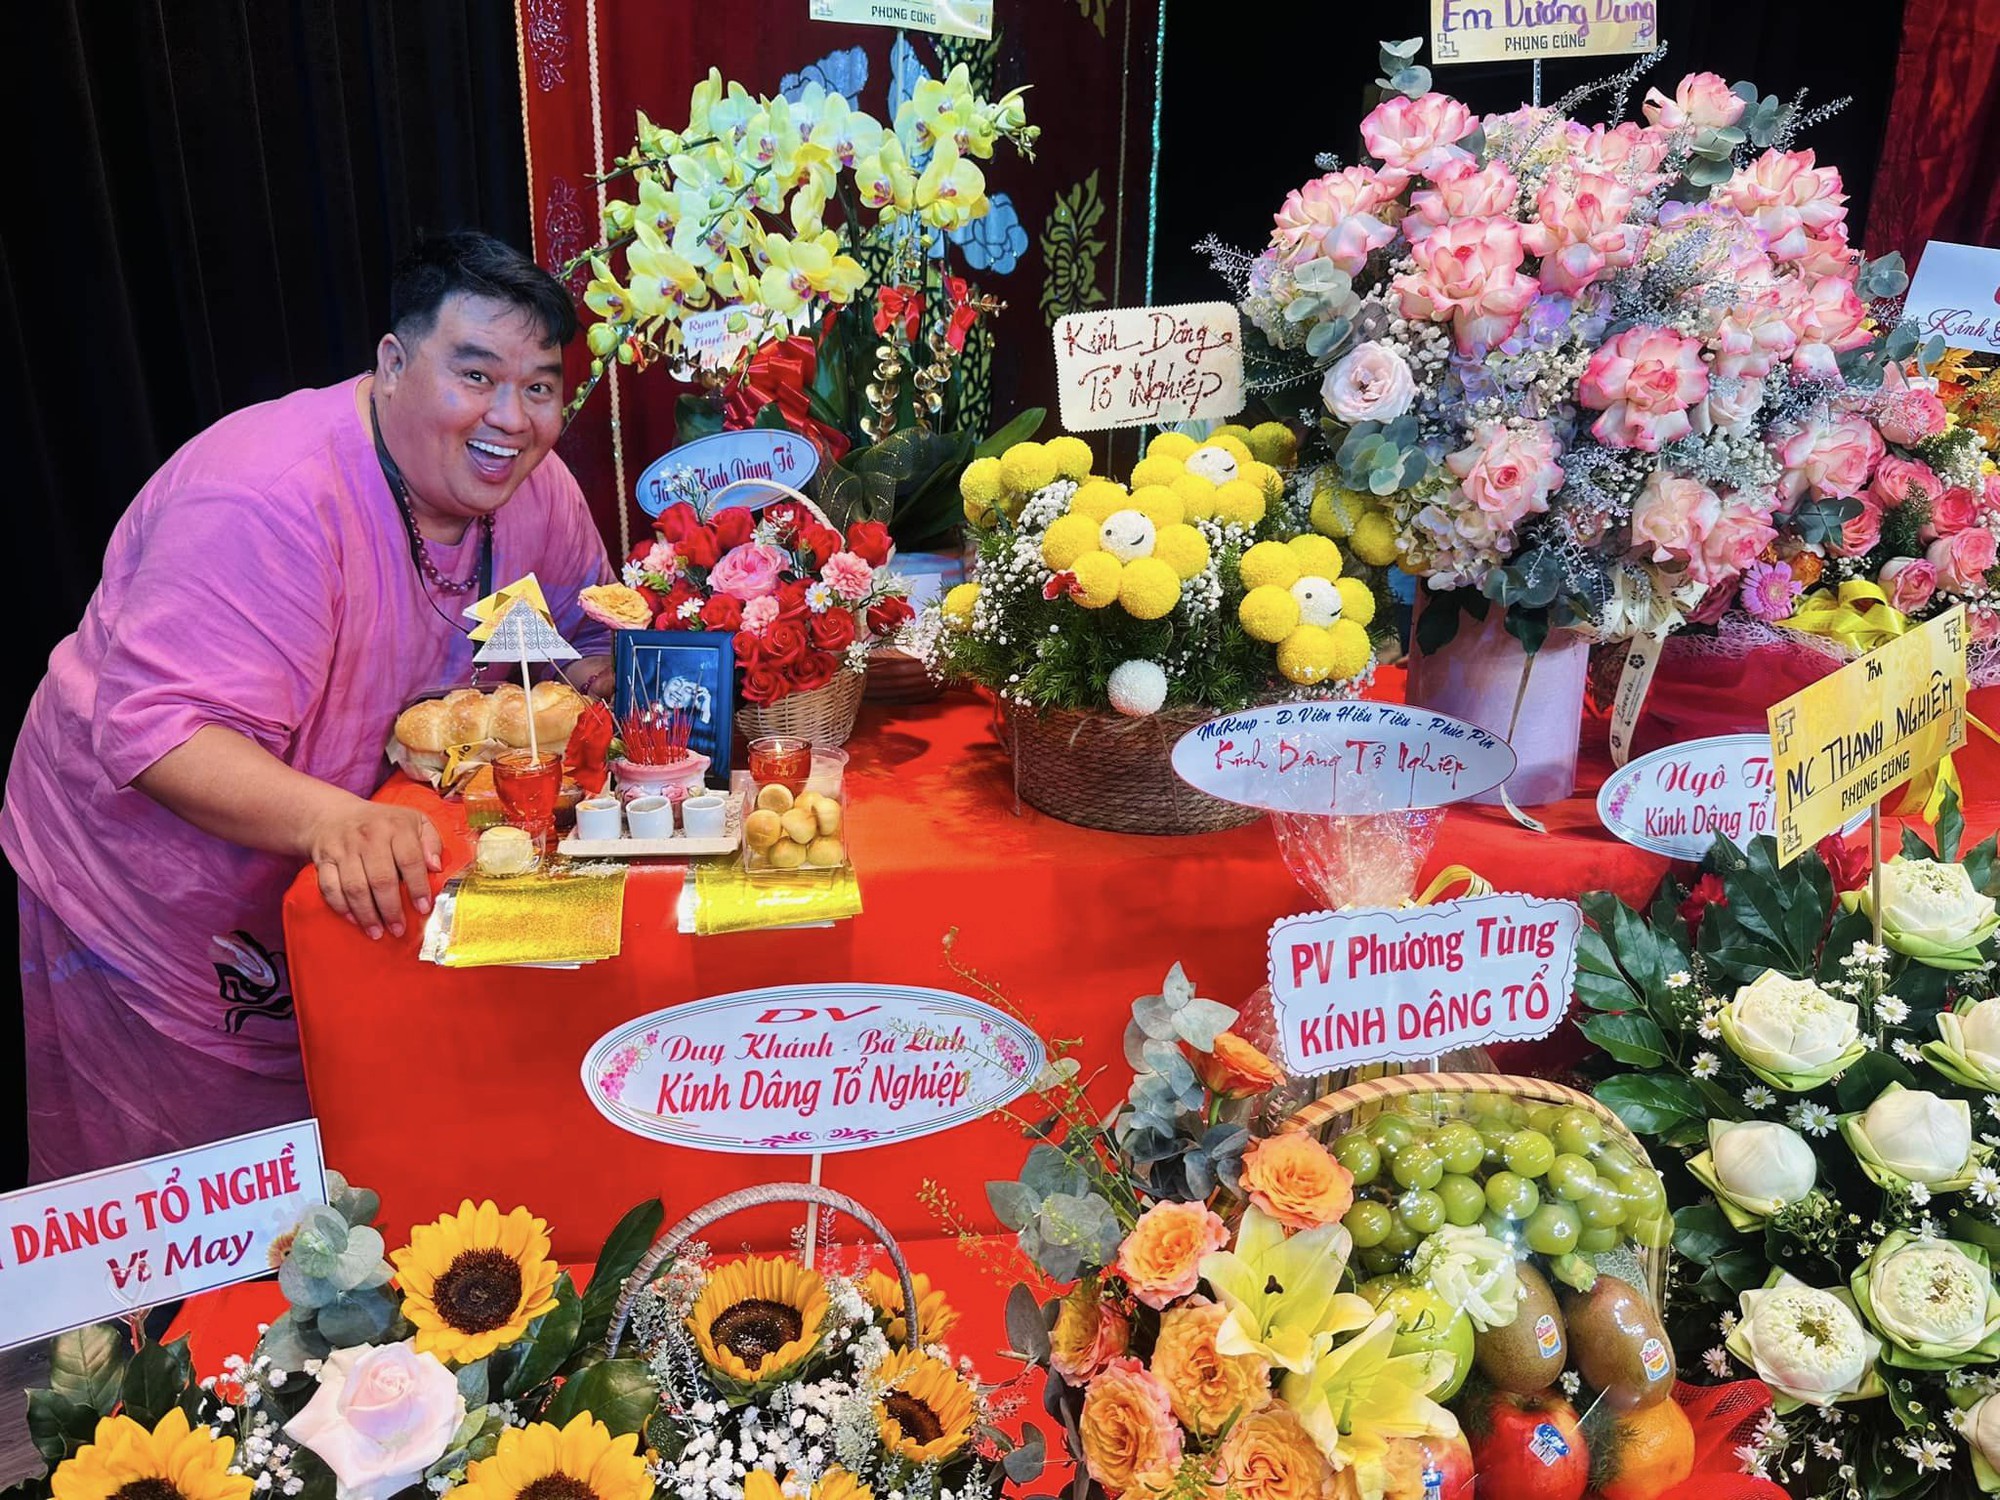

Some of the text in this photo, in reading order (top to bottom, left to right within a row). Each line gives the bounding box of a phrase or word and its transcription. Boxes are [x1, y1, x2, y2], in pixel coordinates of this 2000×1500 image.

[1443, 0, 1492, 32] Em
[1505, 31, 1586, 54] PHỤNG CÚNG
[1920, 308, 1991, 337] Kính
[773, 441, 796, 473] Tổ
[1298, 706, 1332, 723] Viên
[1336, 705, 1373, 723] Hiếu
[1428, 717, 1465, 738] Phúc
[1787, 669, 1952, 813] MC THANH NGHIÊM
[1214, 738, 1269, 771] Kính
[1278, 738, 1342, 809] Dâng
[1397, 740, 1470, 808] Nghiệp
[1656, 761, 1727, 797] Ngô
[1841, 750, 1911, 812] PHỤNG CÚNG
[1645, 806, 1687, 838] Kính
[1693, 803, 1742, 840] Dâng
[1748, 795, 1768, 832] Tổ
[1290, 914, 1560, 990] PV Phương Tùng
[755, 1005, 883, 1025] DV
[1300, 962, 1551, 1058] KÍNH DÂNG TỔ
[660, 1034, 727, 1067] Duy
[733, 1031, 836, 1061] Khánh
[856, 1028, 898, 1056] Bá
[656, 1057, 973, 1118] Kính Dâng Tổ Nghiệp
[10, 1141, 301, 1265] DÂNG TỔ NGHỀ
[164, 1229, 255, 1277] May
